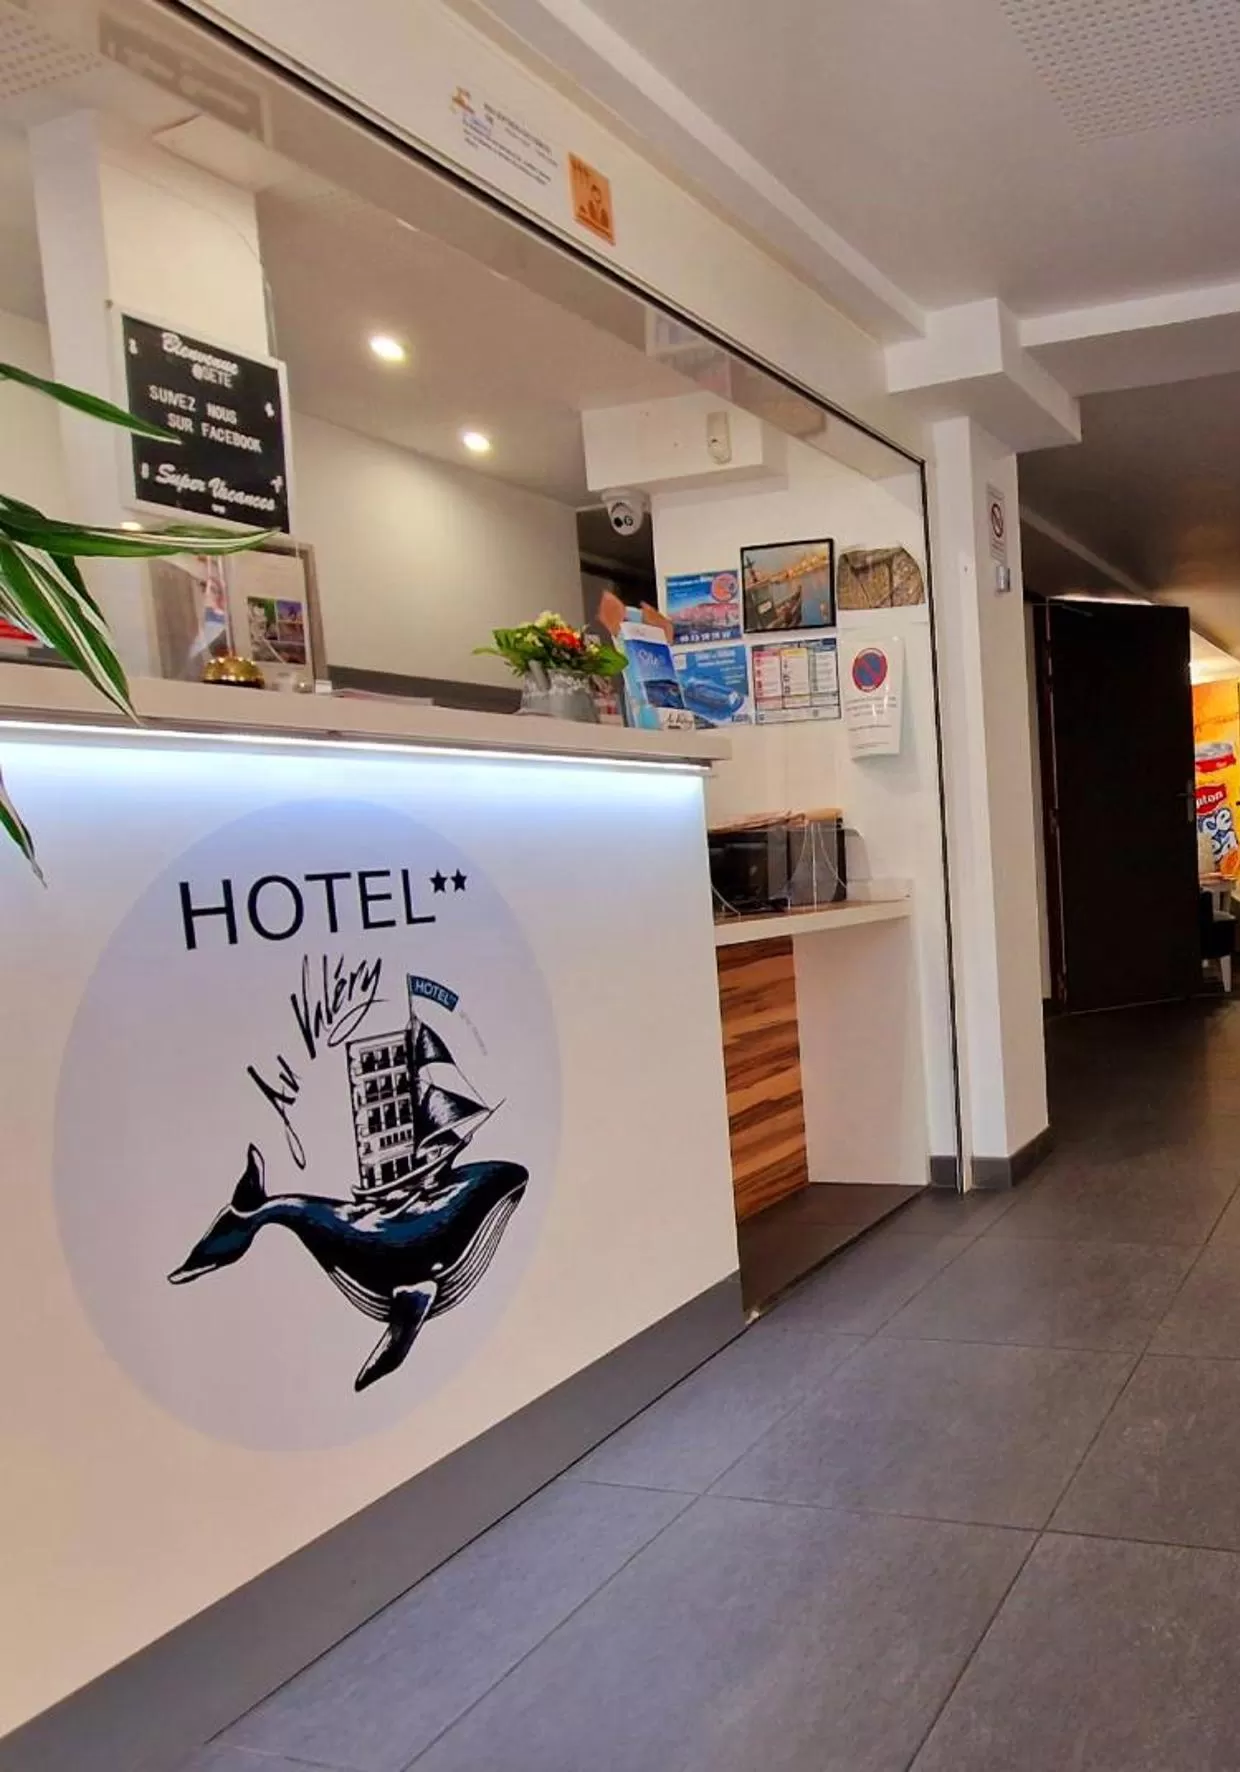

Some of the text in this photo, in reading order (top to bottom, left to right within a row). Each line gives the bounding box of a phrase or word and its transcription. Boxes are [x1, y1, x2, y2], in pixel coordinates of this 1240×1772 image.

[167, 413, 262, 452] SUR FACEBOOK
[206, 403, 237, 425] NOUS
[156, 463, 275, 511] Super Vacances
[179, 869, 436, 950] HOTEL
[415, 979, 449, 1005] HOTEL
[248, 954, 391, 1170] Au Valéry
